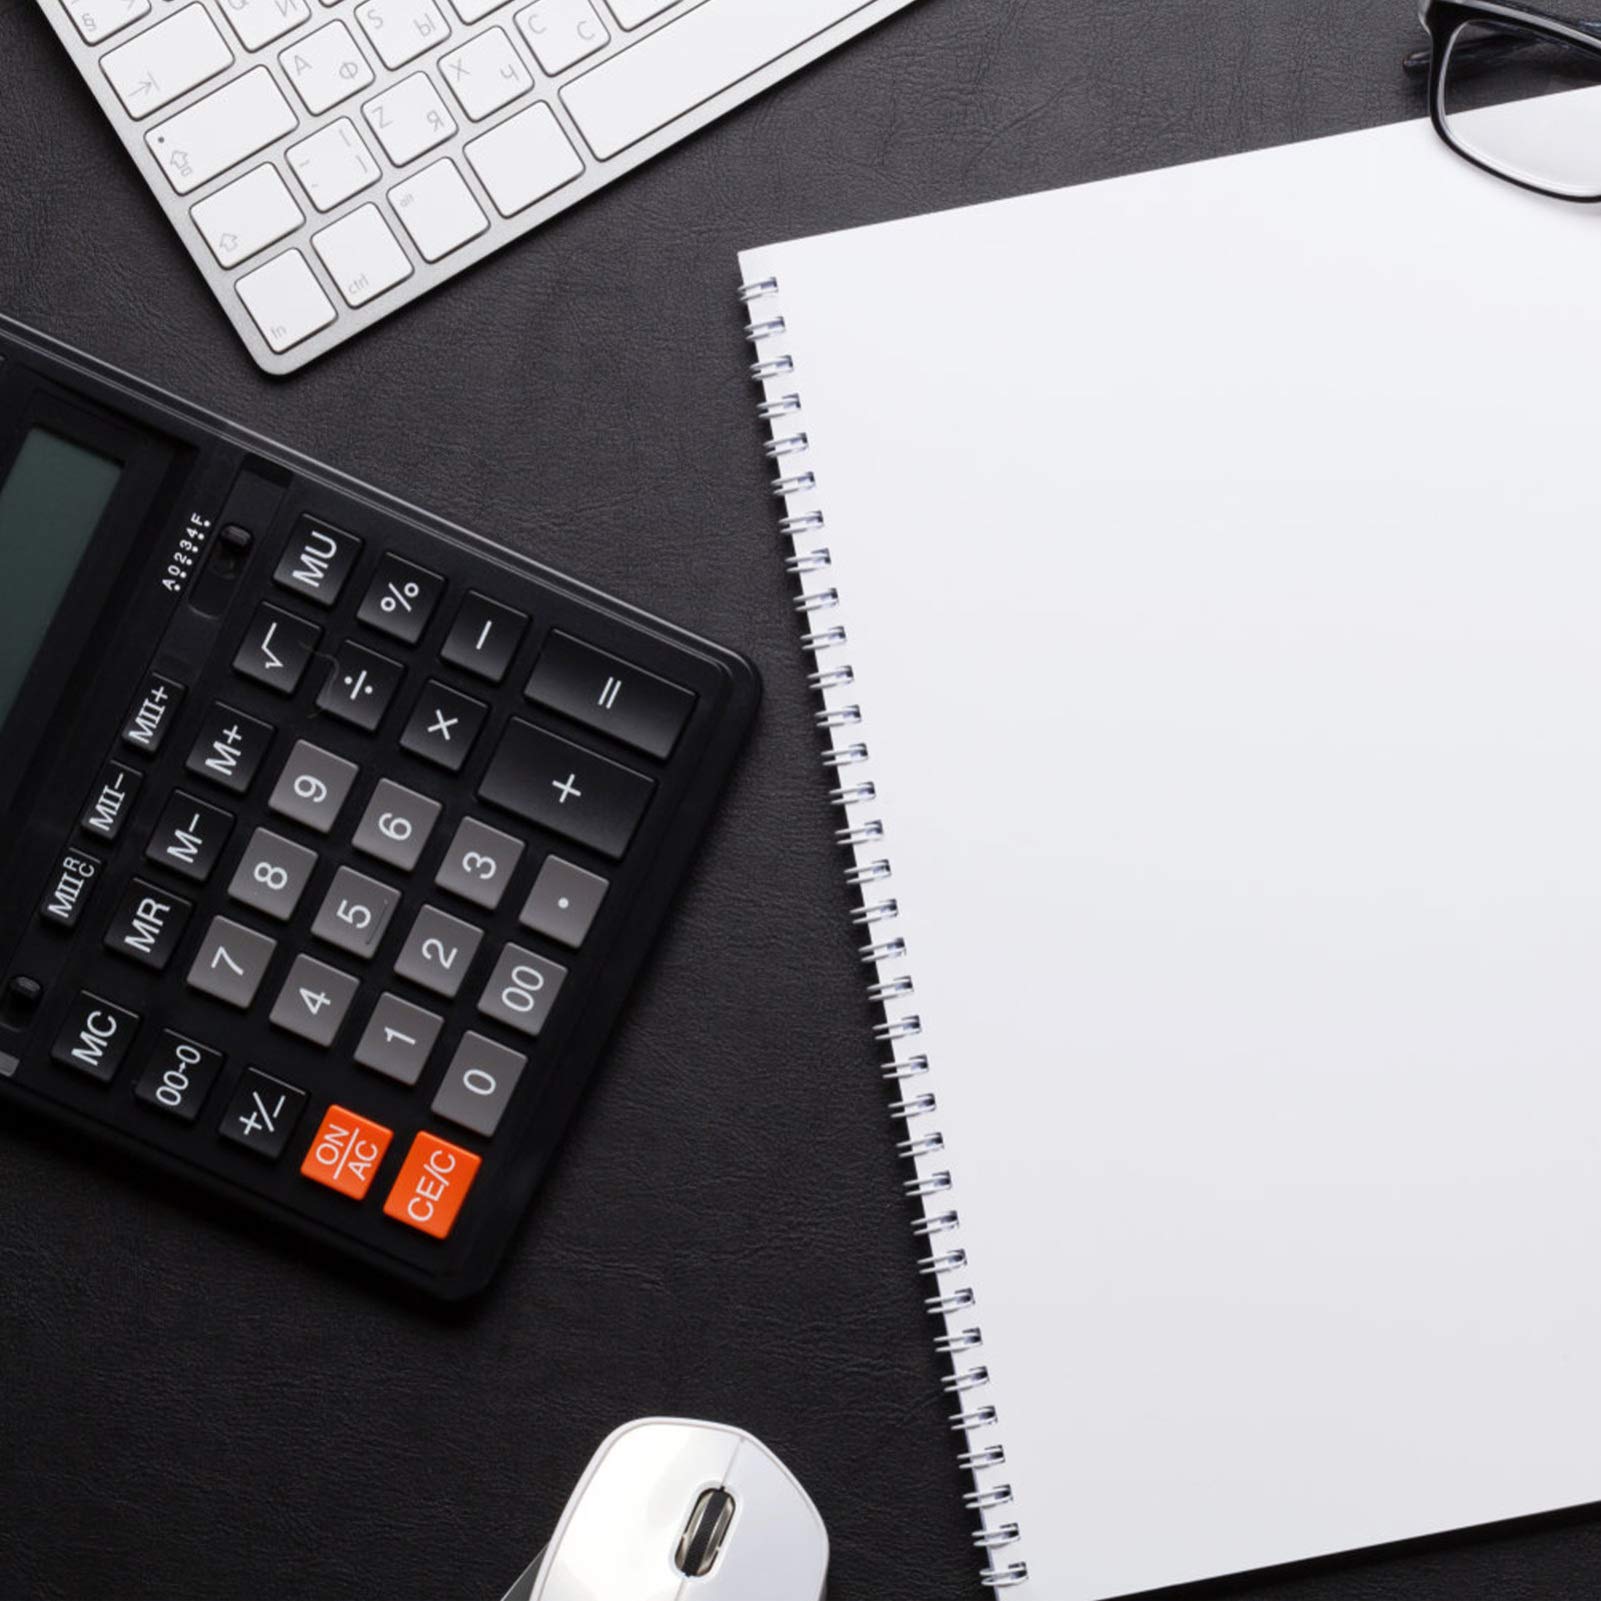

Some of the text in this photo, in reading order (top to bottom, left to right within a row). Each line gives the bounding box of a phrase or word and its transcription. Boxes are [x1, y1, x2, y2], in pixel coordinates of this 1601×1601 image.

[367, 9, 384, 29] S
[528, 14, 547, 34] C
[294, 54, 312, 77] A
[339, 61, 358, 79] Ф
[449, 58, 471, 81] X
[371, 106, 393, 129] Z
[348, 273, 370, 294] ctrl
[291, 530, 338, 588] MU
[205, 725, 243, 776] M+
[294, 774, 328, 803] 9
[167, 813, 203, 864] M-
[378, 812, 412, 841] 6
[253, 861, 289, 891] 8
[462, 851, 497, 880] 3
[124, 898, 171, 953] MR
[337, 898, 372, 929] 5
[211, 945, 245, 976] 7
[422, 937, 458, 969] 2
[299, 987, 332, 1015] 4
[501, 965, 545, 1012] 00
[71, 1010, 118, 1066] MC
[383, 1026, 417, 1046] 1
[463, 1068, 497, 1096] 0
[316, 1123, 350, 1166] ON
[347, 1140, 379, 1182] AC
[407, 1150, 456, 1223] CE/C
